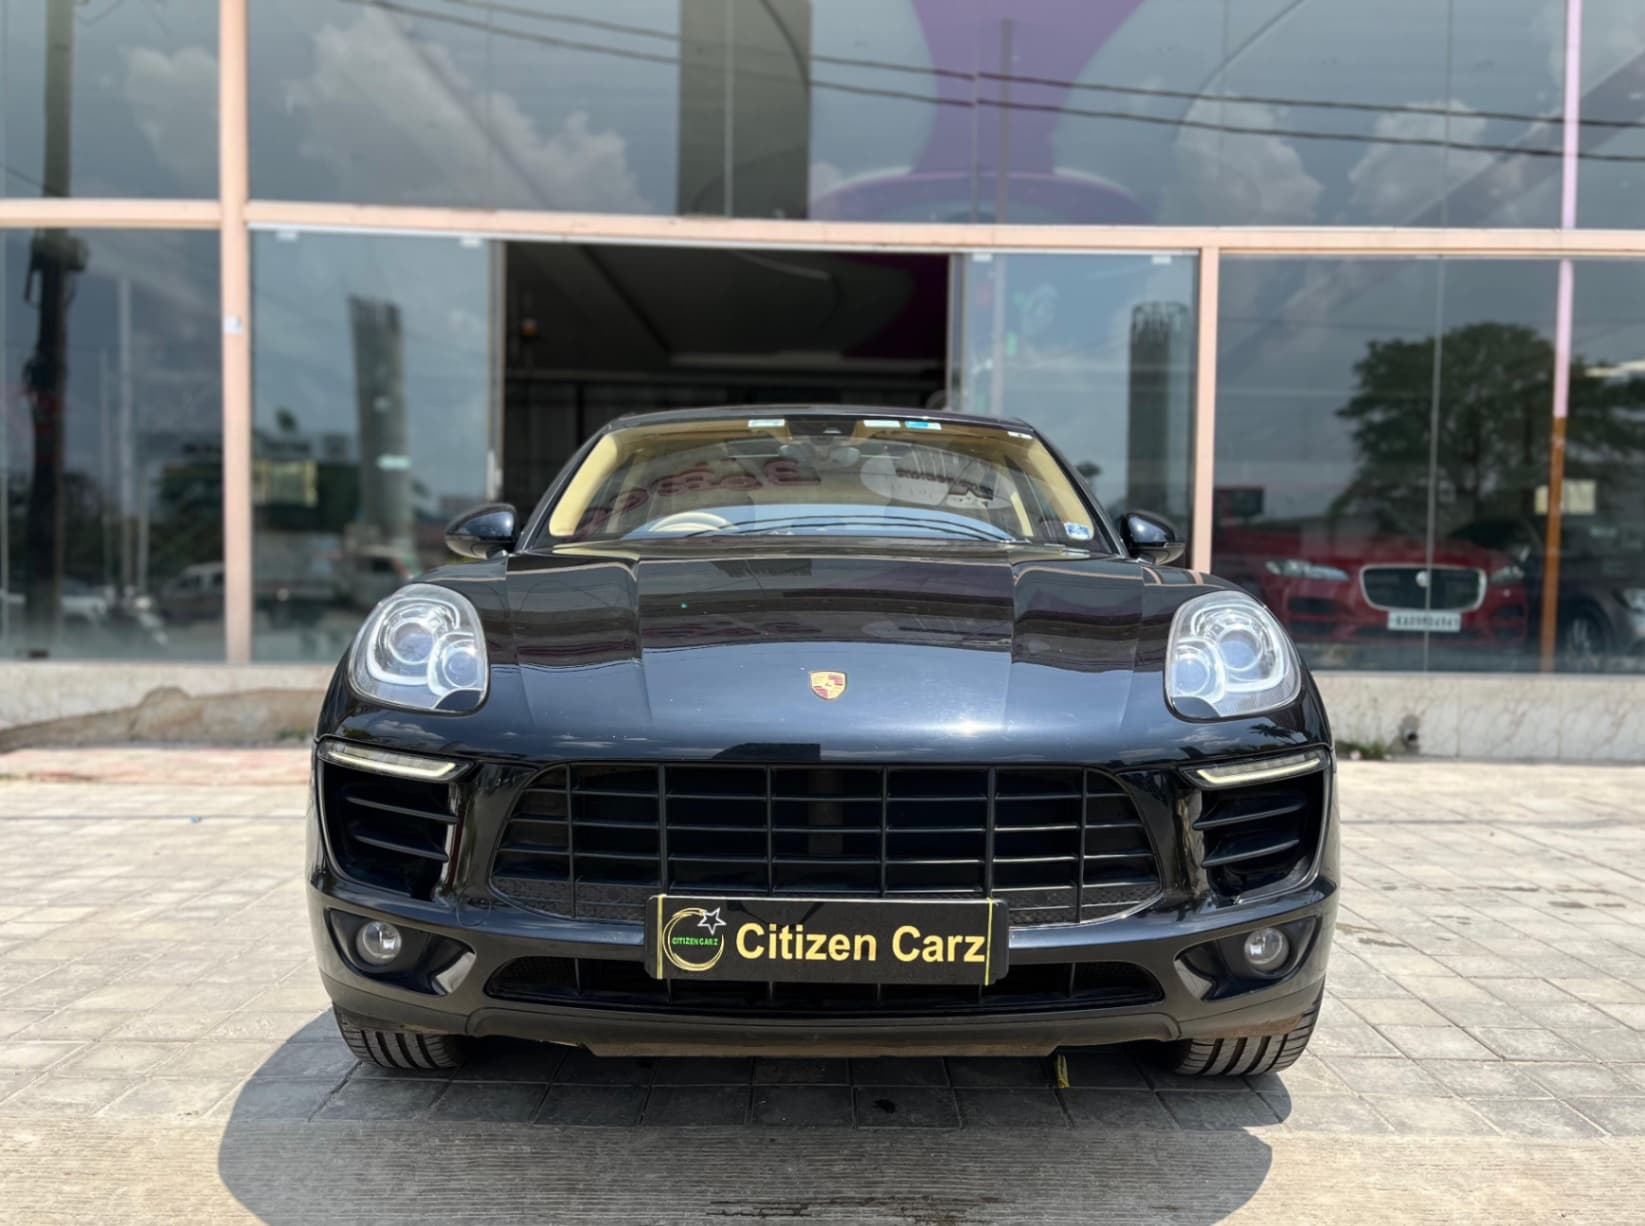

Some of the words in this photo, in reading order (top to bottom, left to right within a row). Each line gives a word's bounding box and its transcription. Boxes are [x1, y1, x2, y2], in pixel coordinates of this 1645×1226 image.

[672, 937, 699, 945] CITIZEN
[736, 923, 876, 961] Citizen
[892, 925, 985, 962] Carz
